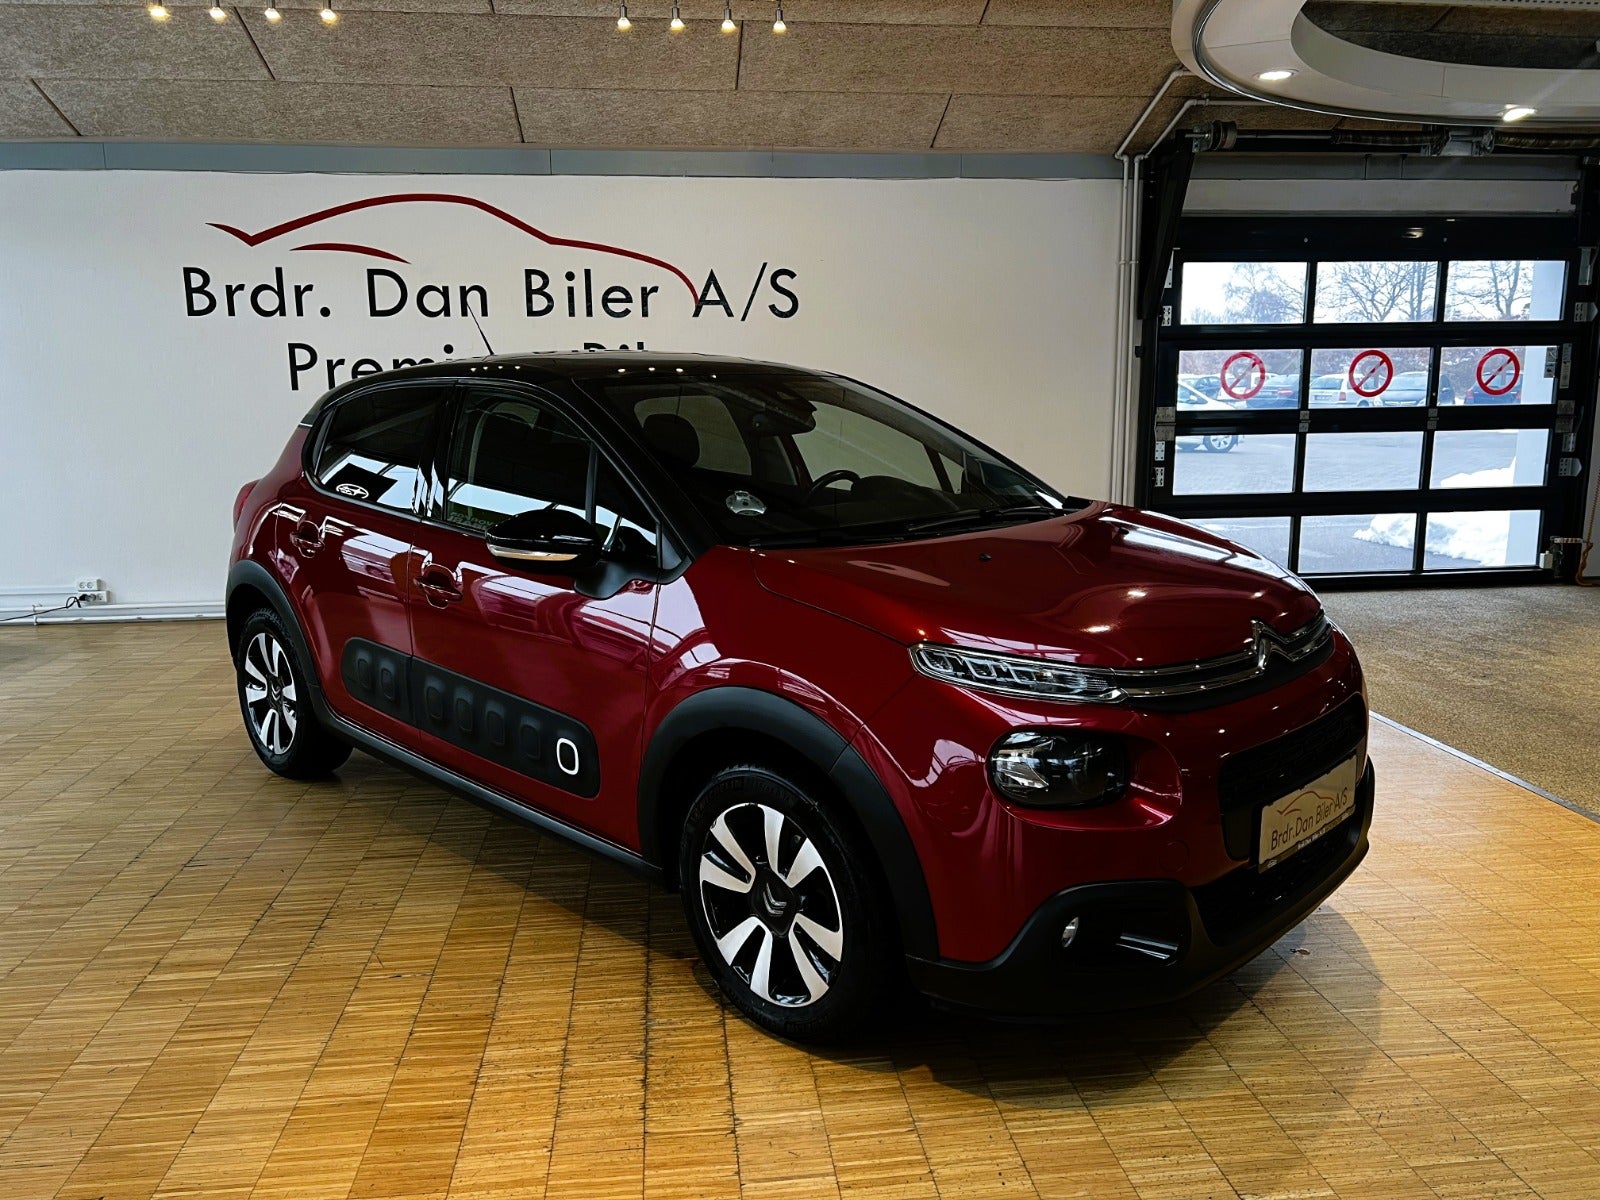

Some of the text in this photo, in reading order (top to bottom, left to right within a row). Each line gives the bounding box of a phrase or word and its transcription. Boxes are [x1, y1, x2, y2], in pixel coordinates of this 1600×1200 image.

[184, 262, 800, 322] Brdr. Dan Biler A/S
